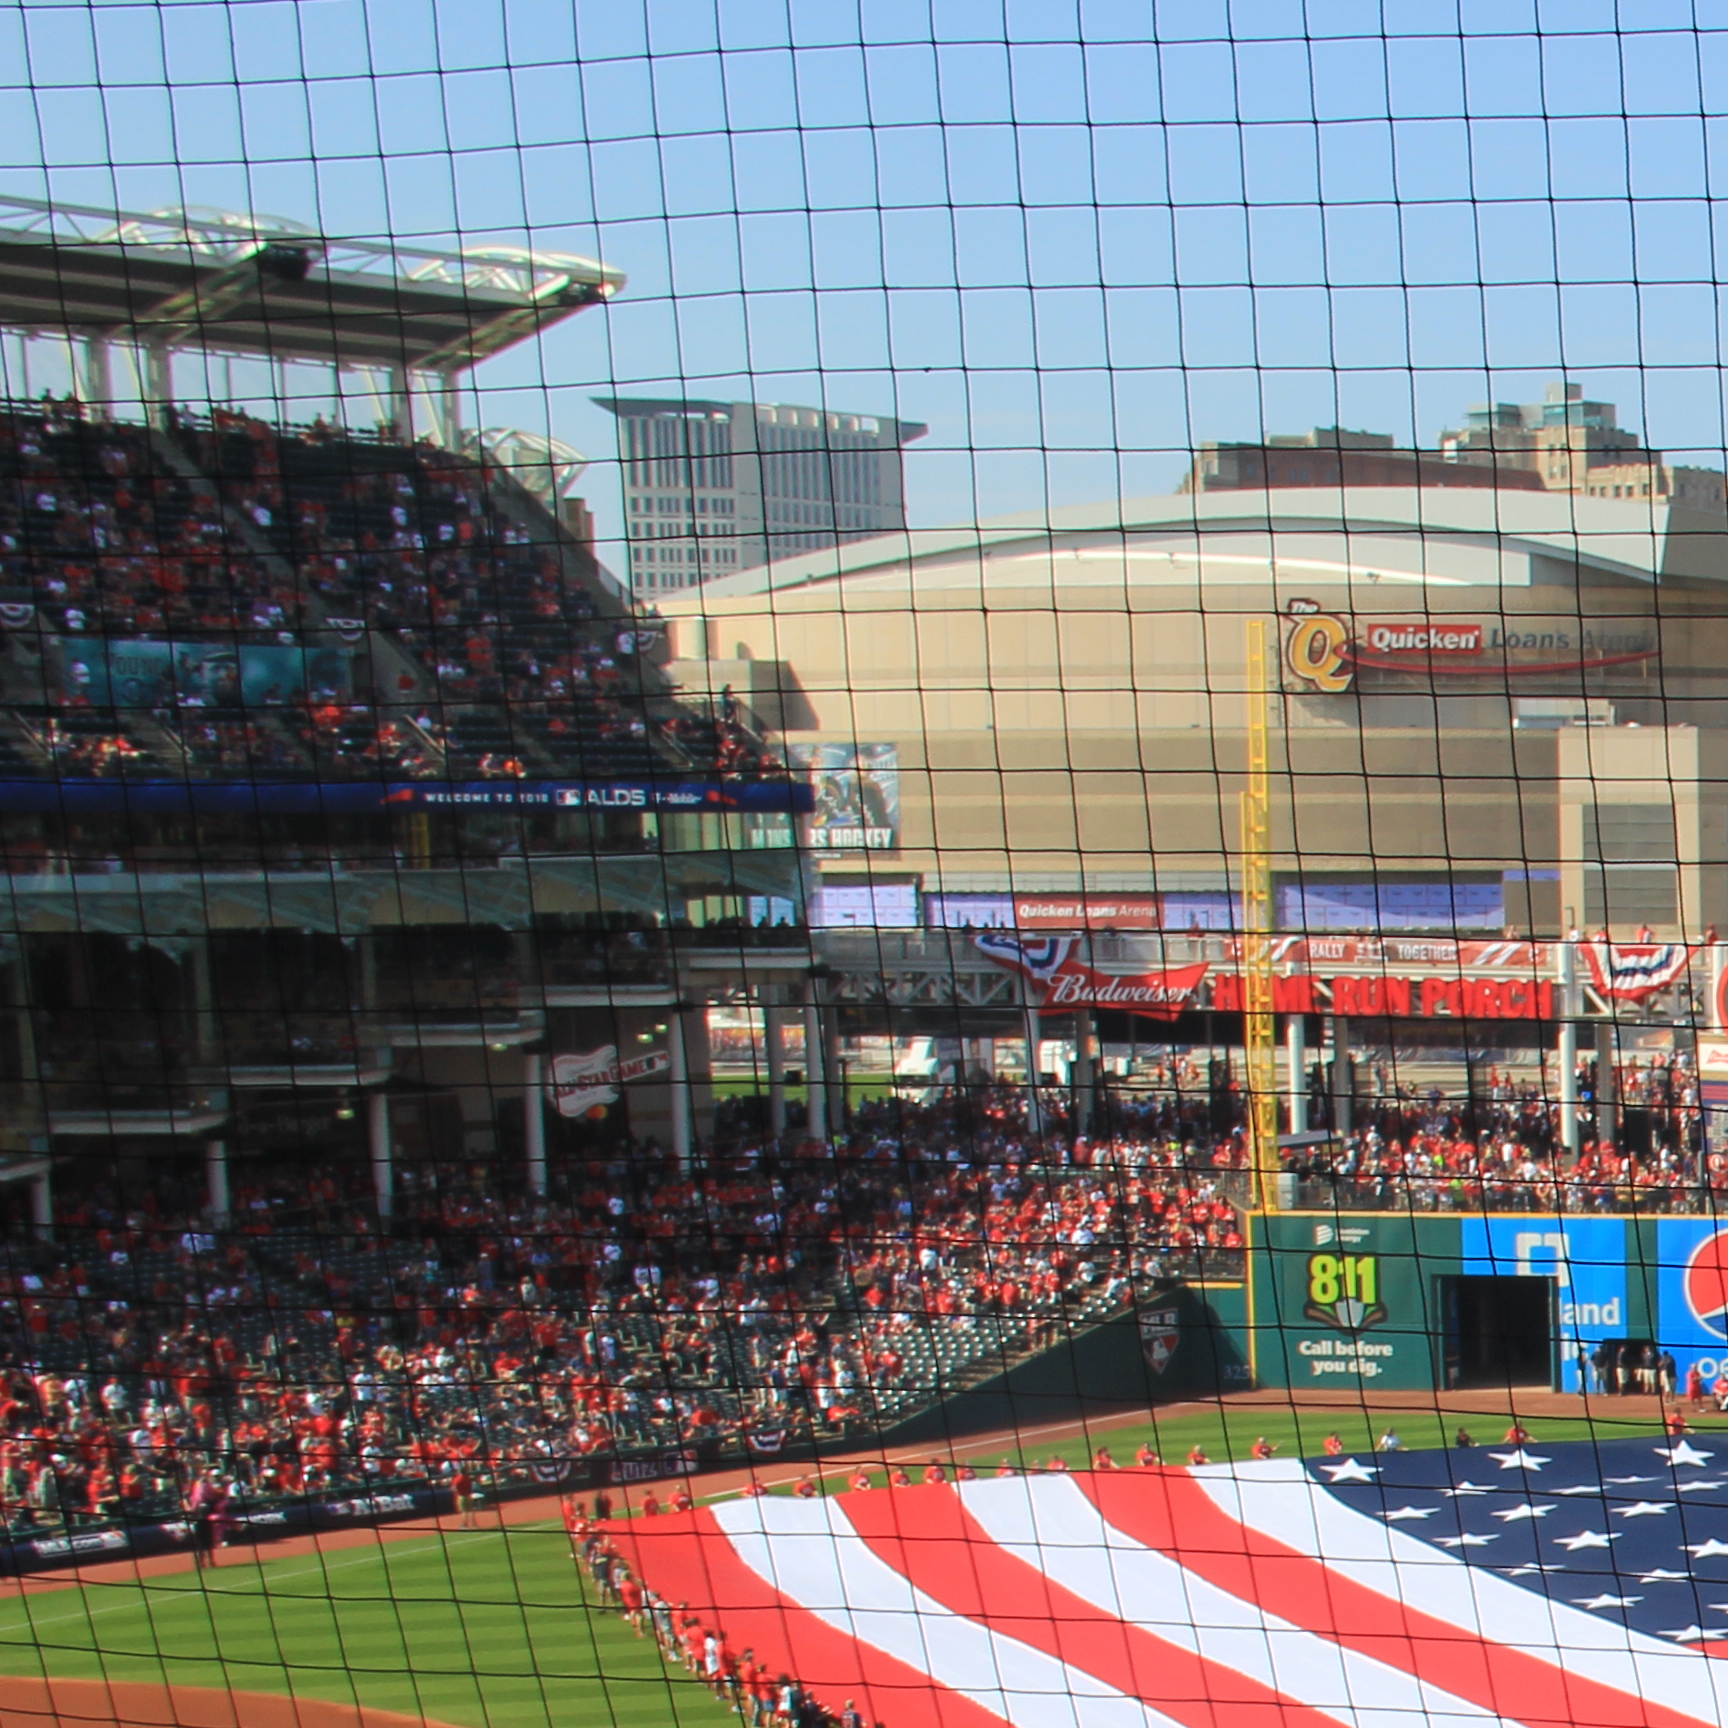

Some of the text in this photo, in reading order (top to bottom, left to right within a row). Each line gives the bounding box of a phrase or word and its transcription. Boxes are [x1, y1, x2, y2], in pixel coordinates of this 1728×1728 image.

[1370, 627, 1478, 653] Quicken
[1490, 628, 1570, 650] Loans
[1288, 614, 1355, 692] Q
[425, 793, 490, 802] WELCOME
[497, 793, 513, 803] TO
[586, 789, 646, 806] ALDS
[830, 827, 893, 848] HOCKEY
[1019, 904, 1157, 918] Quicken Loans Arena
[1309, 943, 1345, 958] RALLY
[1398, 944, 1458, 961] TOGETHER
[1047, 973, 1193, 1003] Budweiser
[1214, 974, 1553, 1019] HME RUN PORCH
[1310, 1254, 1377, 1304] 811
[1298, 1340, 1394, 1357] Call before
[1312, 1360, 1346, 1377] you
